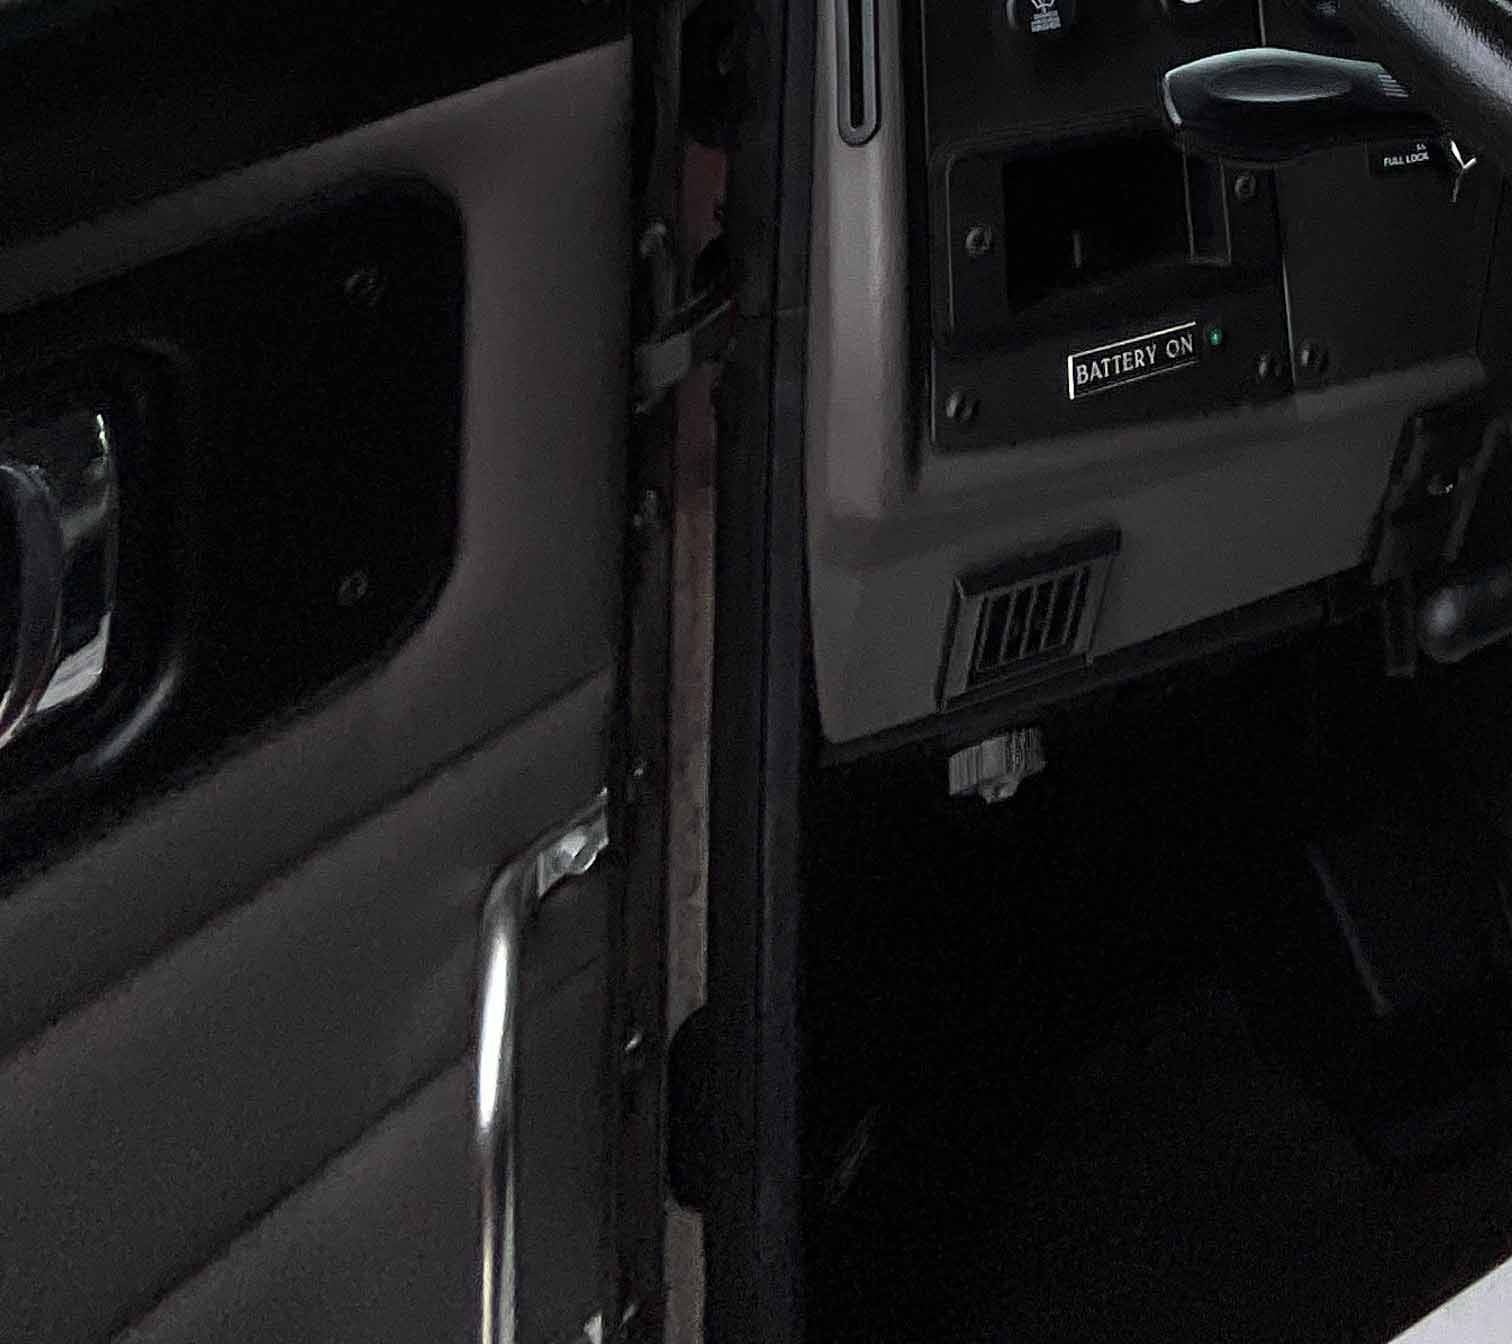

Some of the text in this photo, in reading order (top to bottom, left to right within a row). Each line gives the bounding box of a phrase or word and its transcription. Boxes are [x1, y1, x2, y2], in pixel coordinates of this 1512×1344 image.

[1405, 152, 1430, 164] LOCK
[1075, 333, 1193, 386] BATTERY ON
